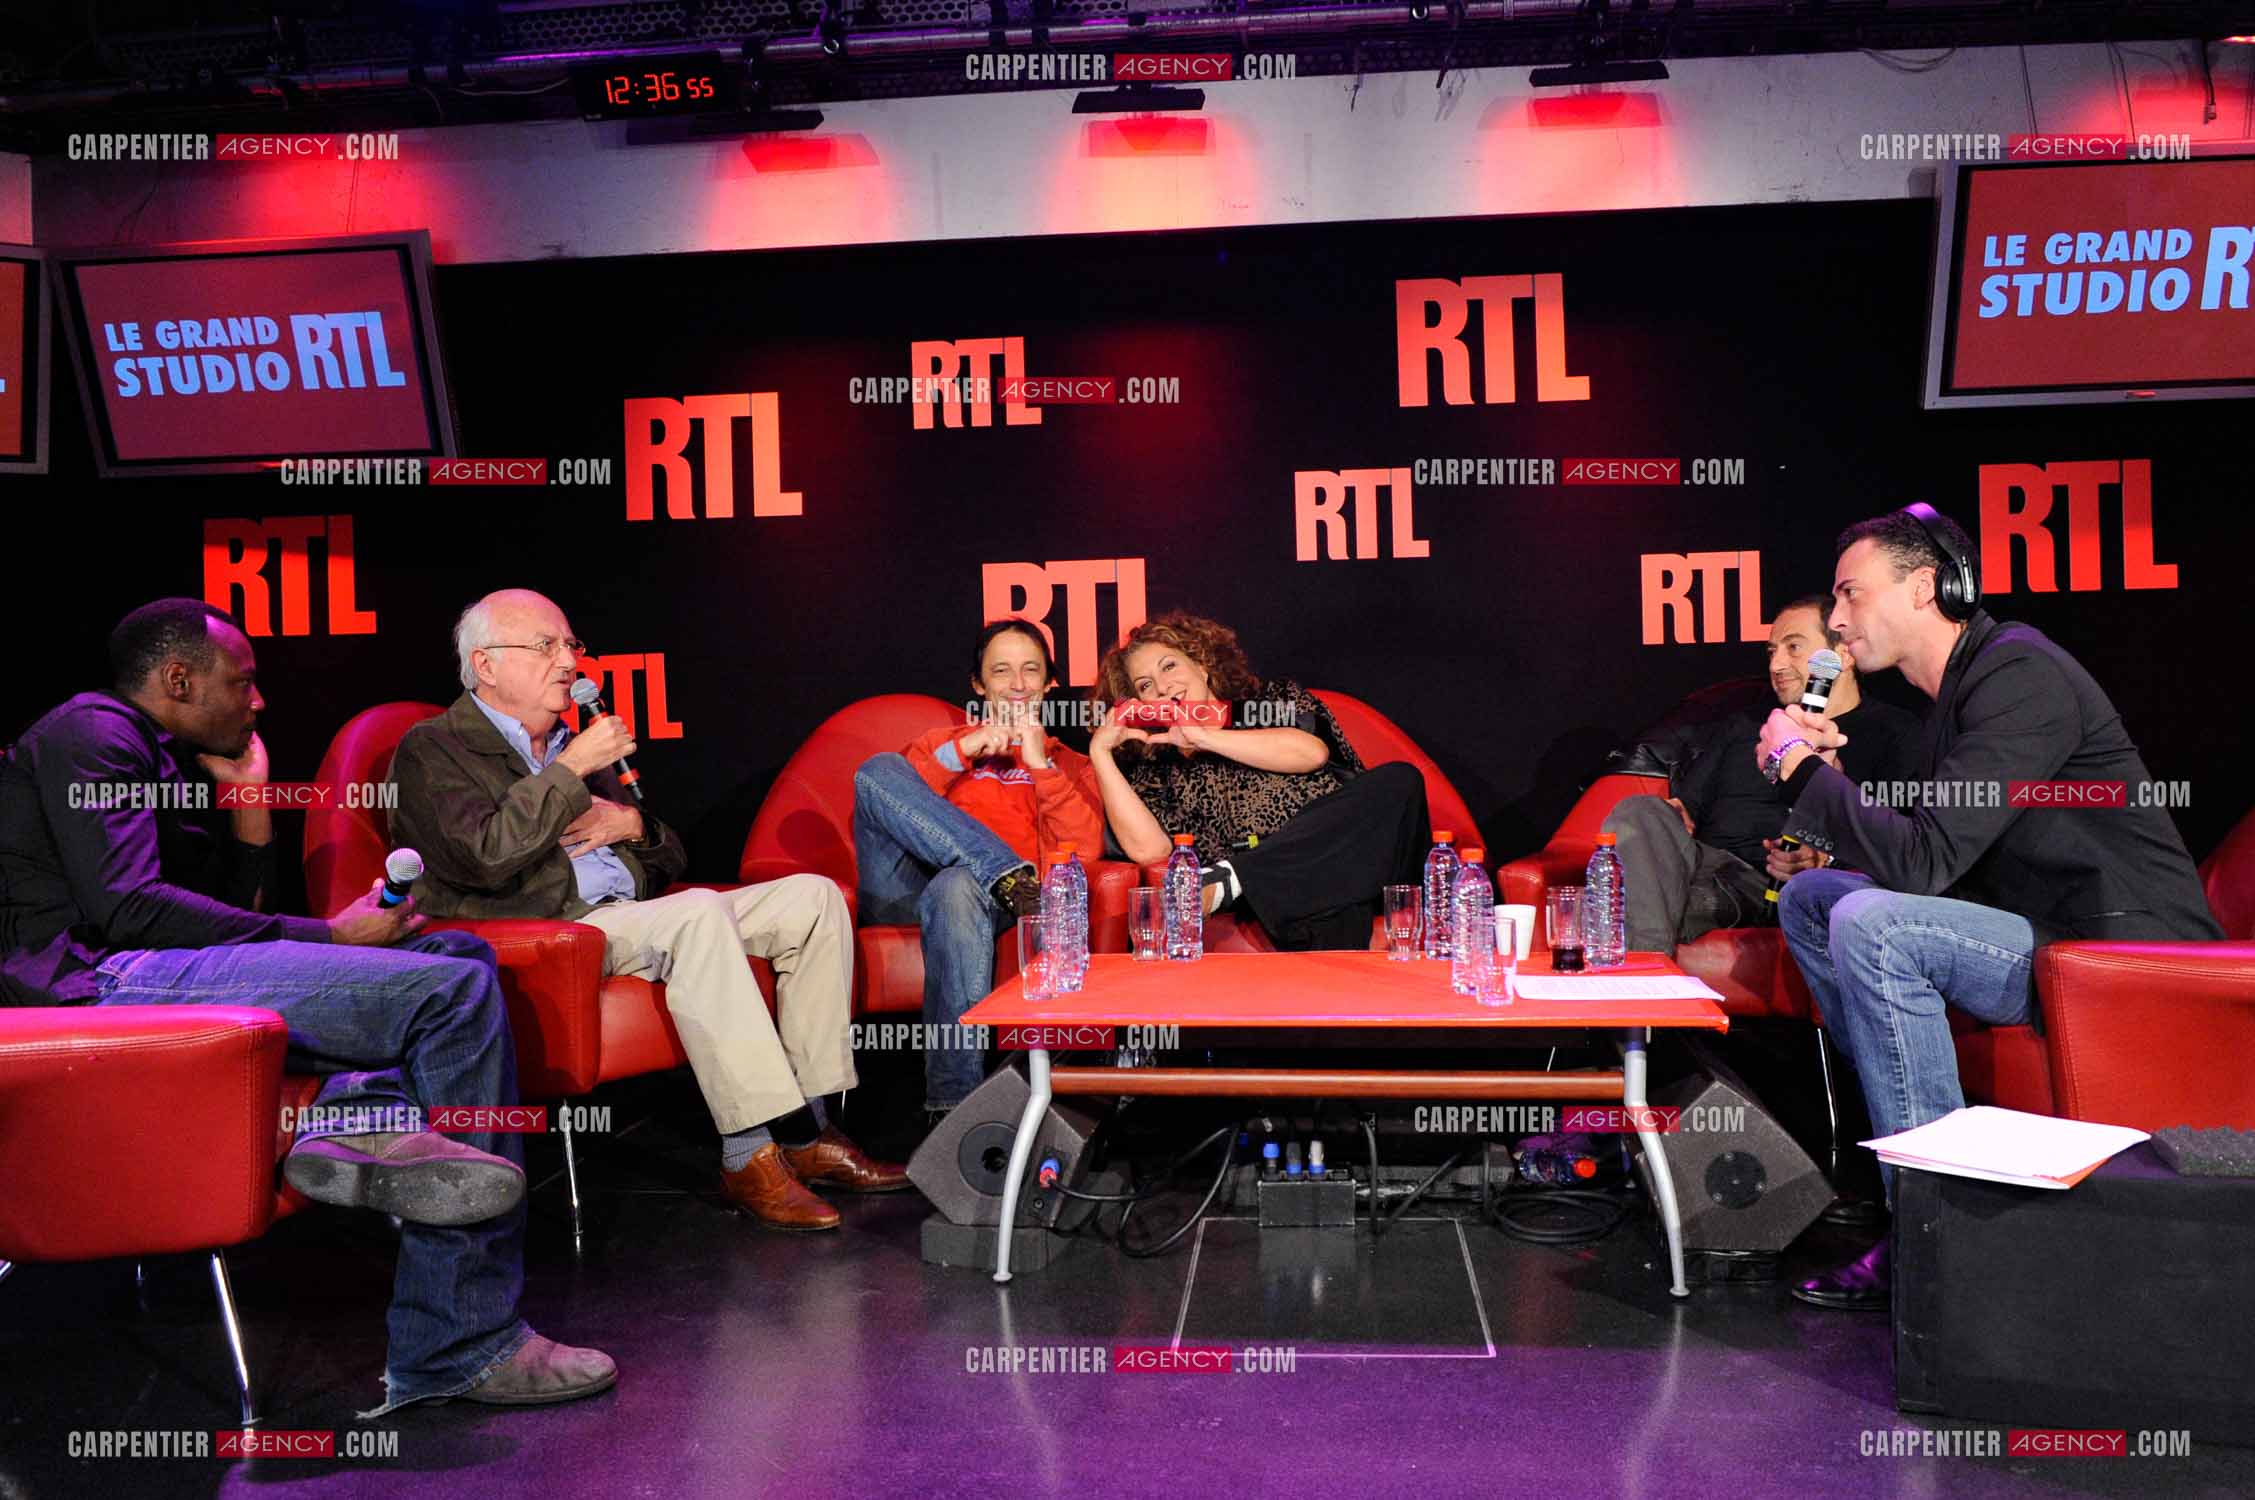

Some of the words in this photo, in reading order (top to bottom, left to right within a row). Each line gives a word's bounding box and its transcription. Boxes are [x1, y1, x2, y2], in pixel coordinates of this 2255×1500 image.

[606, 73, 679, 103] 12:36
[687, 78, 713, 98] 55
[1984, 235, 2026, 267] LE
[2045, 229, 2192, 265] GRAND
[2200, 226, 2255, 310] R
[104, 323, 143, 352] LE
[155, 316, 279, 350] GRAND
[1979, 267, 2191, 318] STUDIO
[113, 352, 290, 397] STUDIO
[290, 311, 406, 391] RTL
[911, 337, 1042, 429] RTL
[1396, 273, 1590, 407] RTL
[625, 393, 803, 521] RTL
[1295, 468, 1430, 561] RTL
[1980, 459, 2179, 594] RTL
[203, 515, 377, 637] RTL
[1640, 550, 1776, 645] RTL
